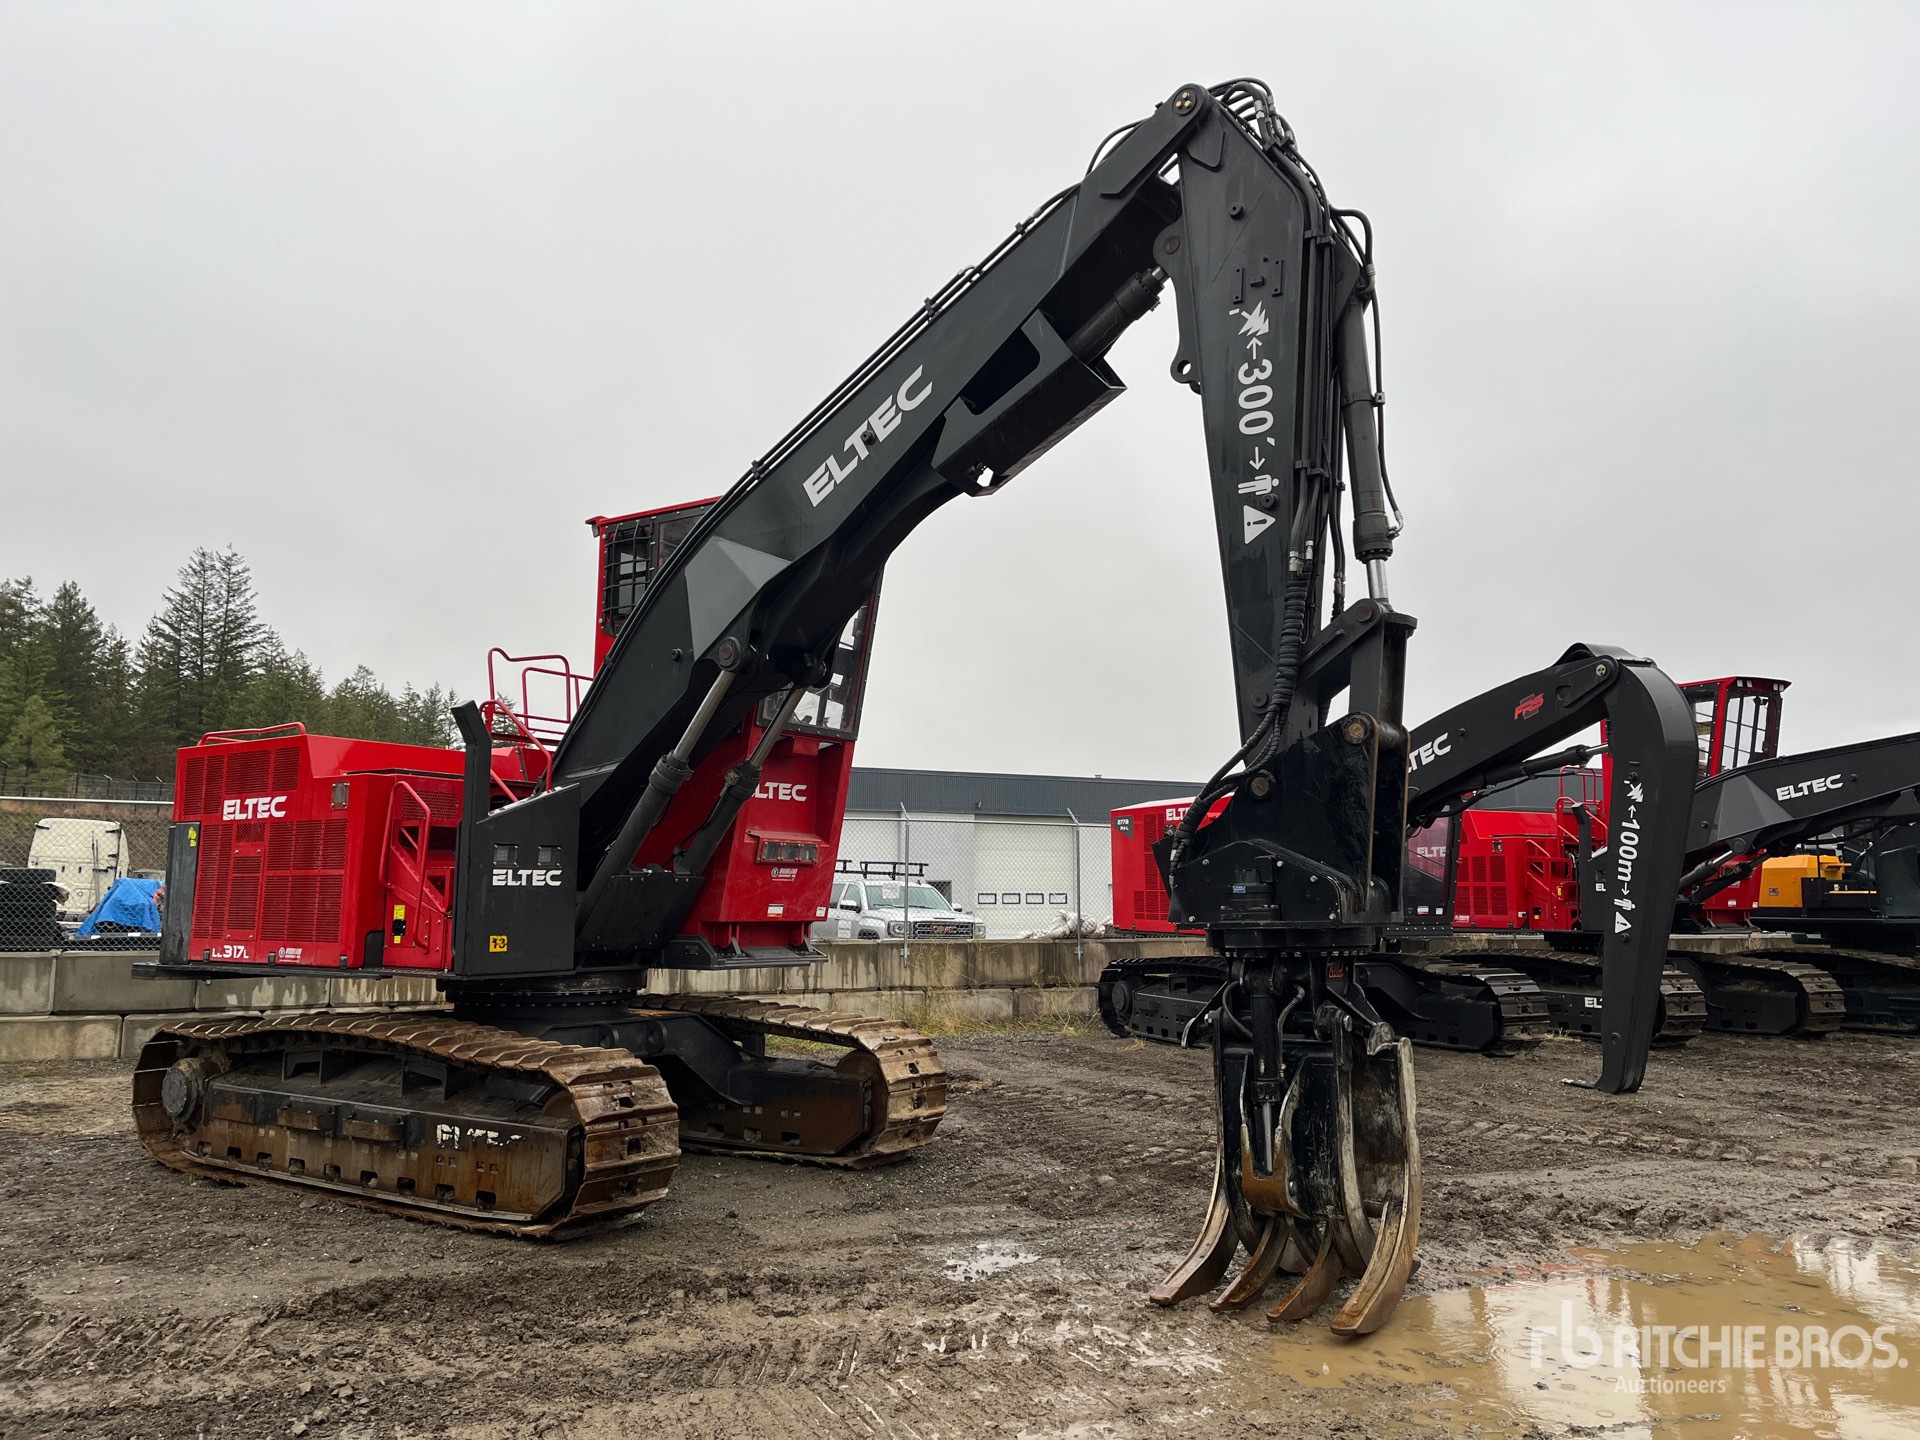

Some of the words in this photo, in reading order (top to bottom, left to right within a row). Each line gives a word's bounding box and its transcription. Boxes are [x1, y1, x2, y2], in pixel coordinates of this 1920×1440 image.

[802, 364, 933, 508] ELTEC
[1408, 732, 1452, 774] TEC
[751, 781, 808, 802] LTEC
[1776, 773, 1844, 801] ELTEC
[222, 795, 288, 821] ELTEC
[1617, 819, 1641, 882] 100m
[492, 868, 563, 886] ELTEC
[1584, 996, 1603, 1009] EL
